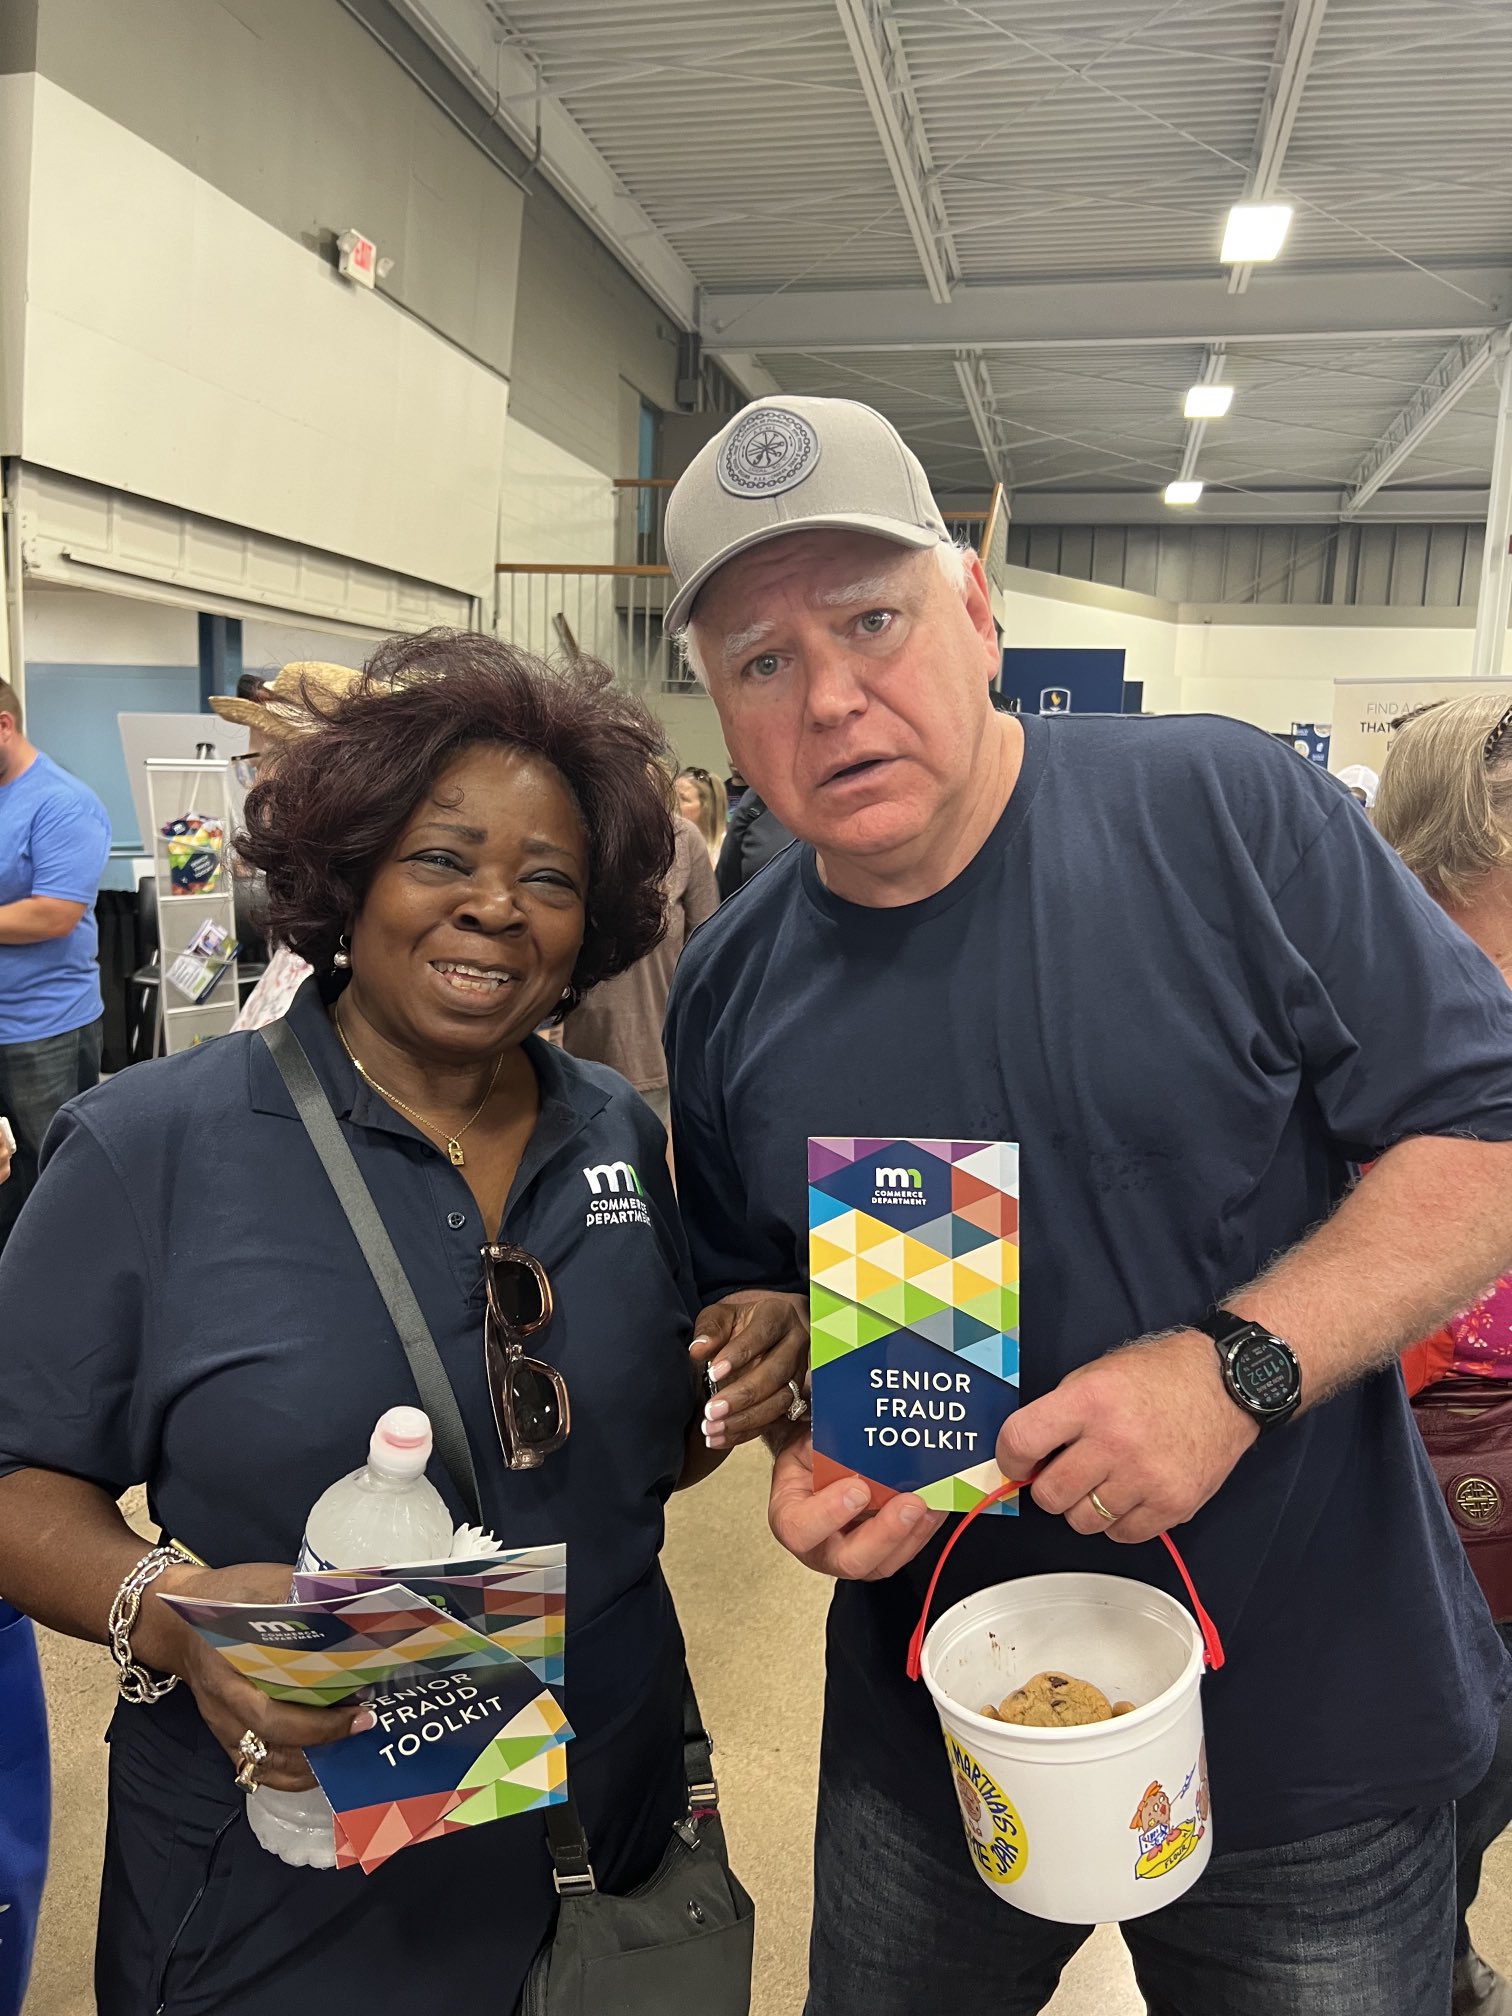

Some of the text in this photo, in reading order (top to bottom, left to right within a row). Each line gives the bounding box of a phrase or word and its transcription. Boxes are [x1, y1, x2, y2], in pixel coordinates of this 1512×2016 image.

[1367, 703, 1399, 715] FIND
[1360, 721, 1391, 733] THAT
[871, 1197, 927, 1206] DEPARTMENT
[874, 1190, 924, 1199] COMMERCE
[869, 1368, 971, 1394] SENIOR
[876, 1398, 967, 1422] FRAUD
[863, 1426, 978, 1451] TOOLKIT
[261, 1630, 318, 1639] COMMERCE
[359, 1673, 472, 1710] SENIOR
[378, 1686, 478, 1733] FRAUD
[378, 1695, 502, 1767] TOOLKIT
[951, 1740, 1018, 1836] MARTHA'S
[1163, 1844, 1188, 1869] FLOUR
